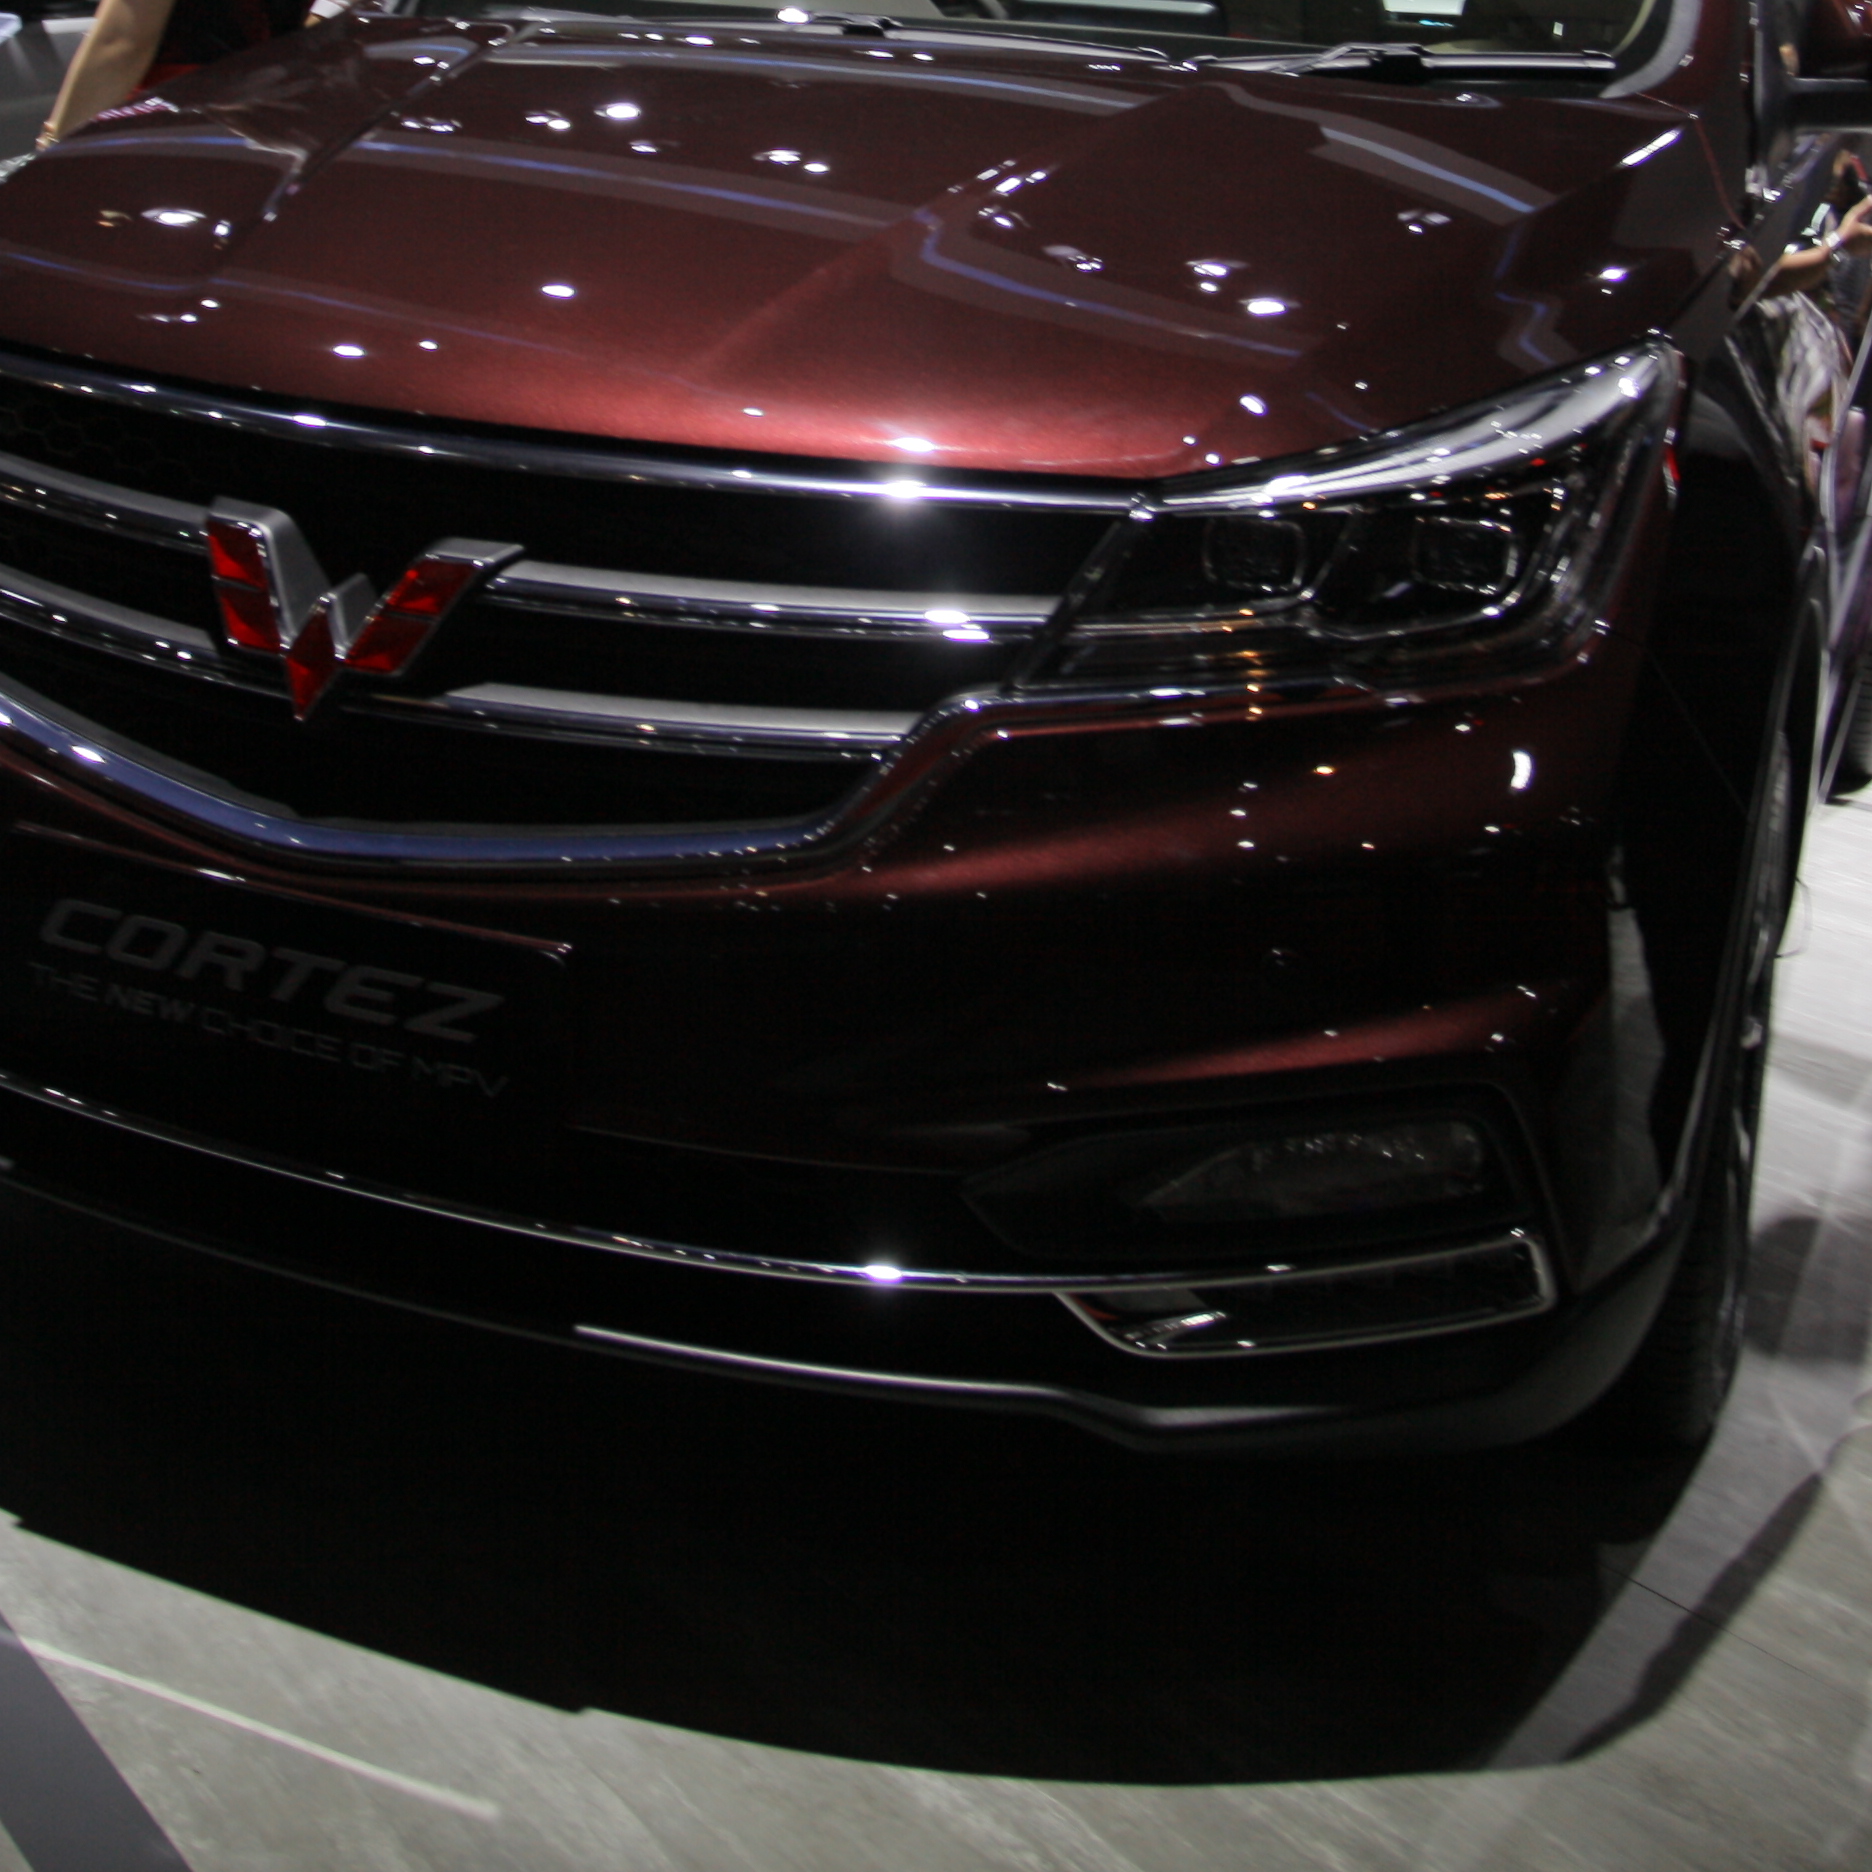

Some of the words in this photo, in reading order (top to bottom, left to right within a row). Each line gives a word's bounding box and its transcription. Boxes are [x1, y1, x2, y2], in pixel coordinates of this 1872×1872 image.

[28, 960, 99, 1003] THE
[103, 982, 195, 1025] NEW
[200, 1005, 344, 1065] CHOICE
[345, 1041, 407, 1073] OF
[411, 1055, 511, 1099] MPV
[38, 898, 506, 1045] CORTEZ
